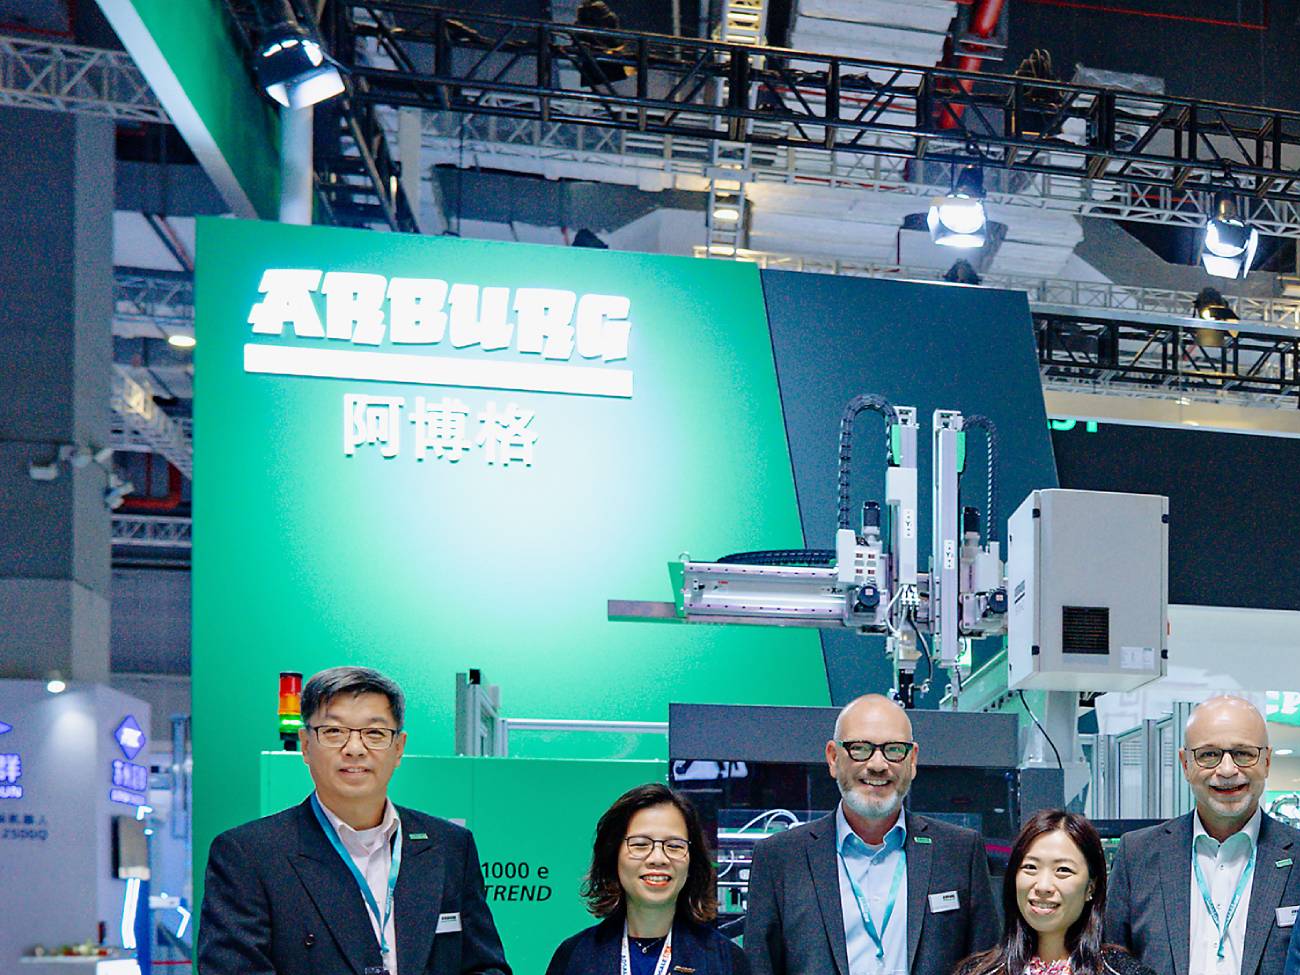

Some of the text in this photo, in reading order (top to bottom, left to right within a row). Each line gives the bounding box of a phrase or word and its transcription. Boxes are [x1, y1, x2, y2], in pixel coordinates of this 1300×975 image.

[248, 268, 632, 363] ARBURG
[343, 393, 539, 468] 阿博格
[481, 861, 550, 879] 1000 e
[484, 884, 552, 902] TREND
